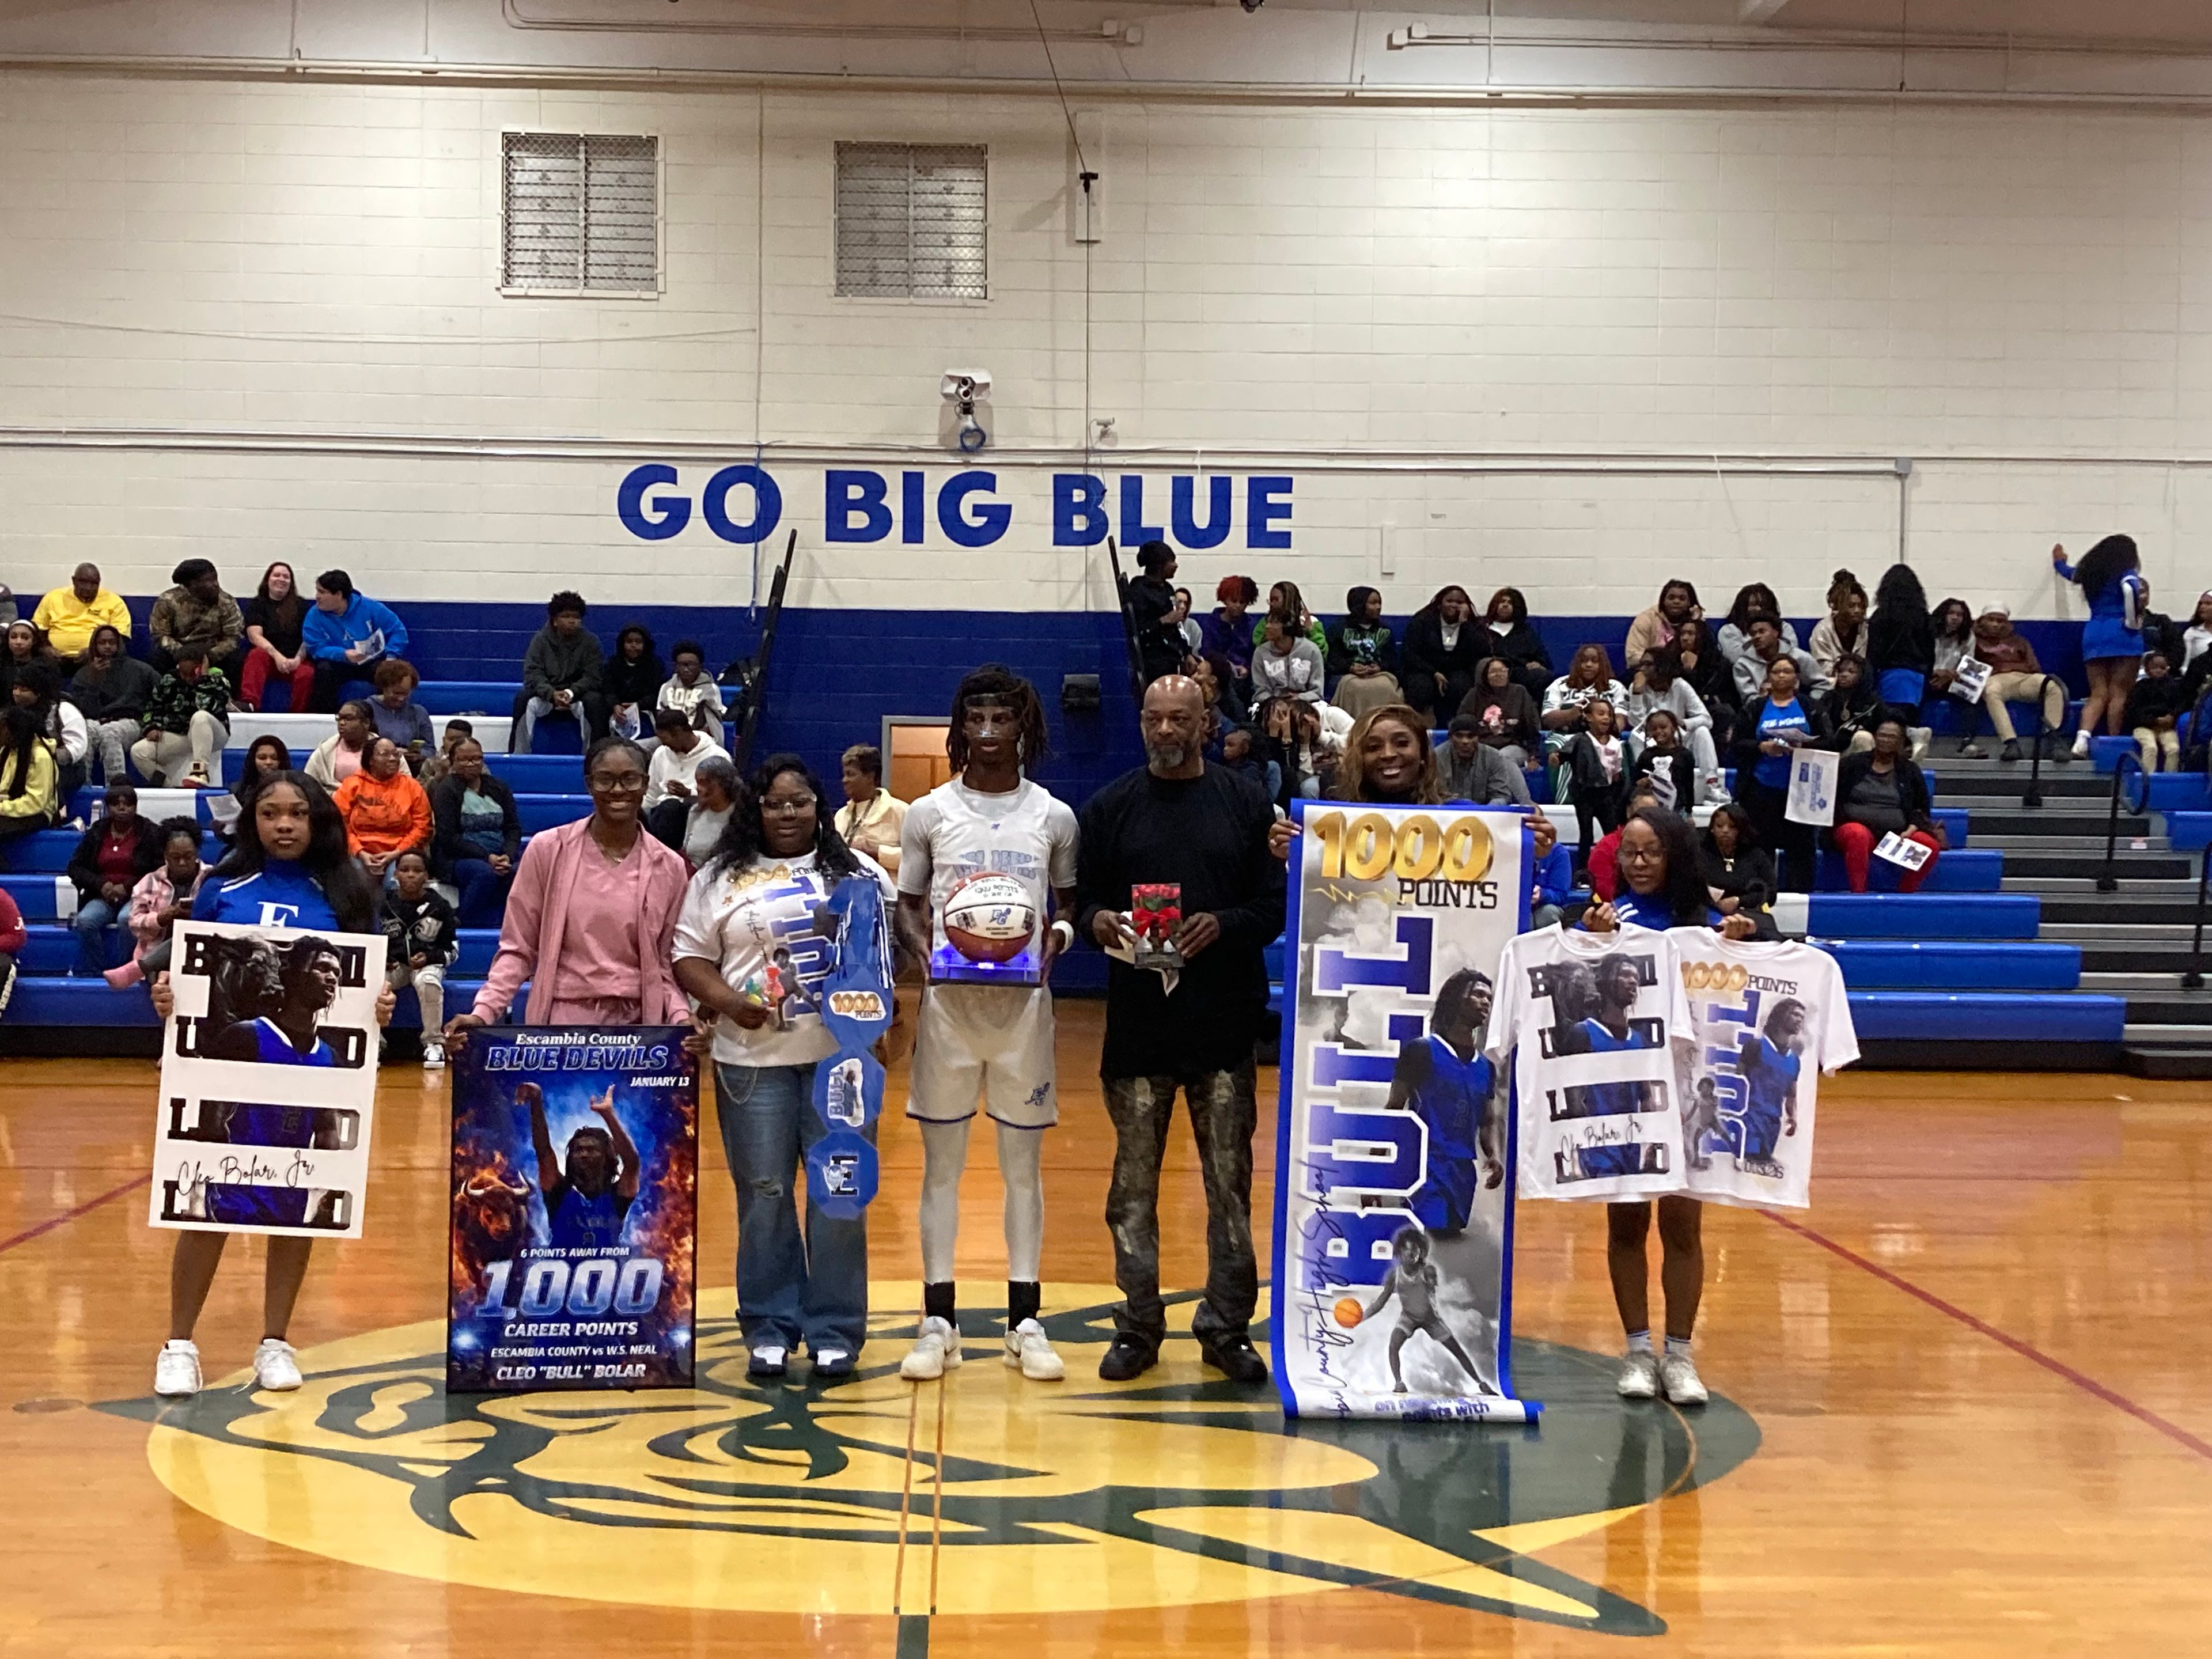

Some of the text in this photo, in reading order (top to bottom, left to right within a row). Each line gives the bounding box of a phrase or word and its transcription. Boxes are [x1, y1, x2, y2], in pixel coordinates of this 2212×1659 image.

[617, 463, 1293, 550] GO BIG BLUE
[1313, 810, 1494, 881] 1000
[1397, 878, 1498, 909] POINTS
[1748, 975, 1798, 995] POINTS
[832, 994, 879, 1013] 1000
[516, 1033, 641, 1046] Escambia County
[485, 1045, 668, 1071] BLUE DEVILS
[630, 1076, 690, 1088] JANUARY 13
[1301, 916, 1434, 1291] BULL
[830, 1154, 859, 1197] E
[521, 1247, 630, 1257] 6 POINTS AWAY FROM
[475, 1258, 664, 1321] 1,000
[505, 1321, 638, 1337] CAREER POINTS
[491, 1347, 546, 1358] ESCAMBIA
[548, 1346, 590, 1357] COUNTY
[630, 1344, 657, 1355] NEAL
[497, 1366, 536, 1380] CLEO
[593, 1363, 646, 1378] BOLAR
